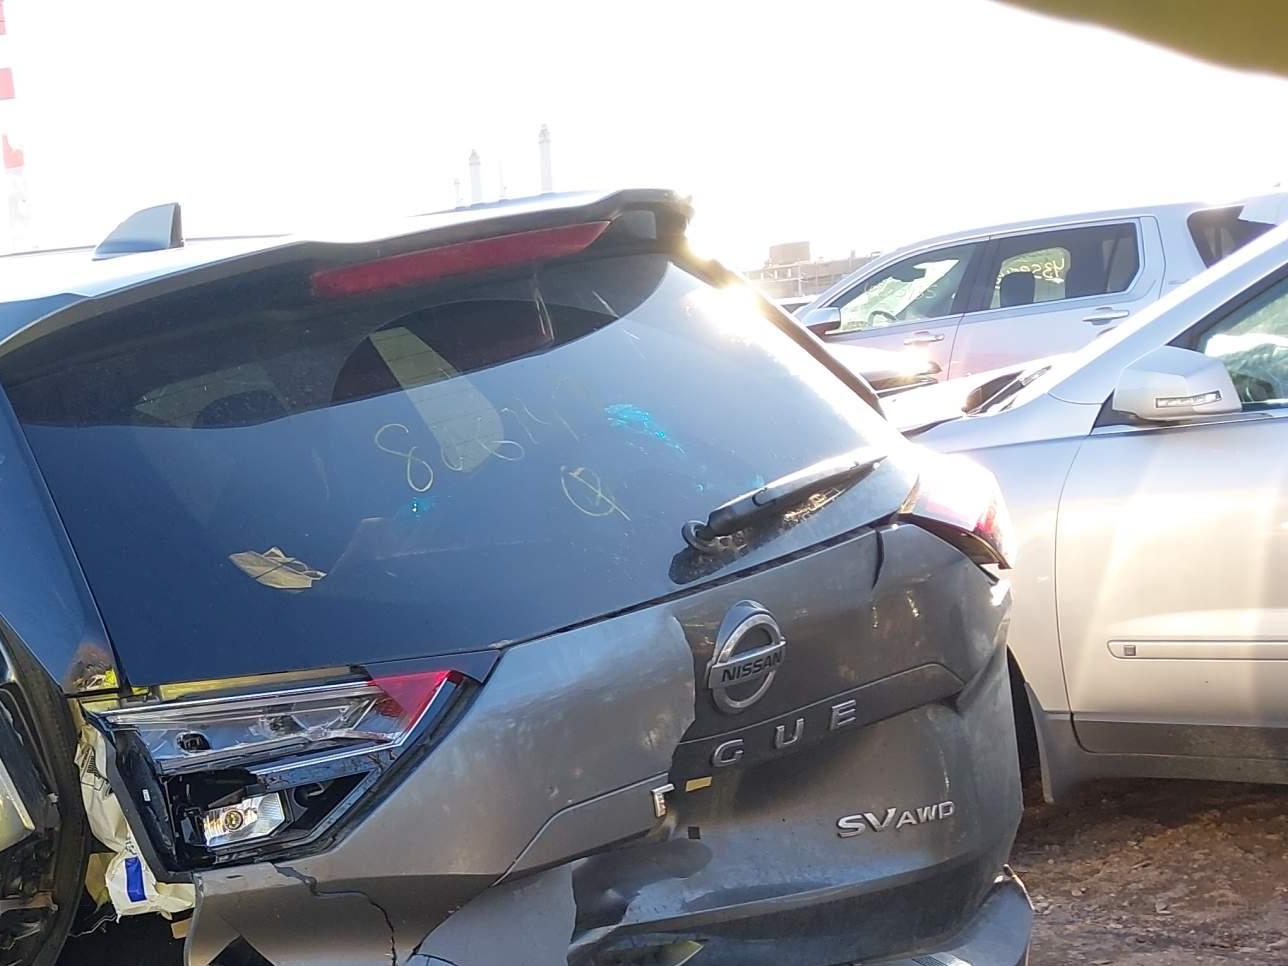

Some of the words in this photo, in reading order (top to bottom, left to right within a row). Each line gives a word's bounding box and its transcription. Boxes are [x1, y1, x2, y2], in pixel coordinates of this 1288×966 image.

[721, 650, 785, 684] NISSAN
[837, 807, 898, 839] SV
[896, 801, 955, 831] AWD
